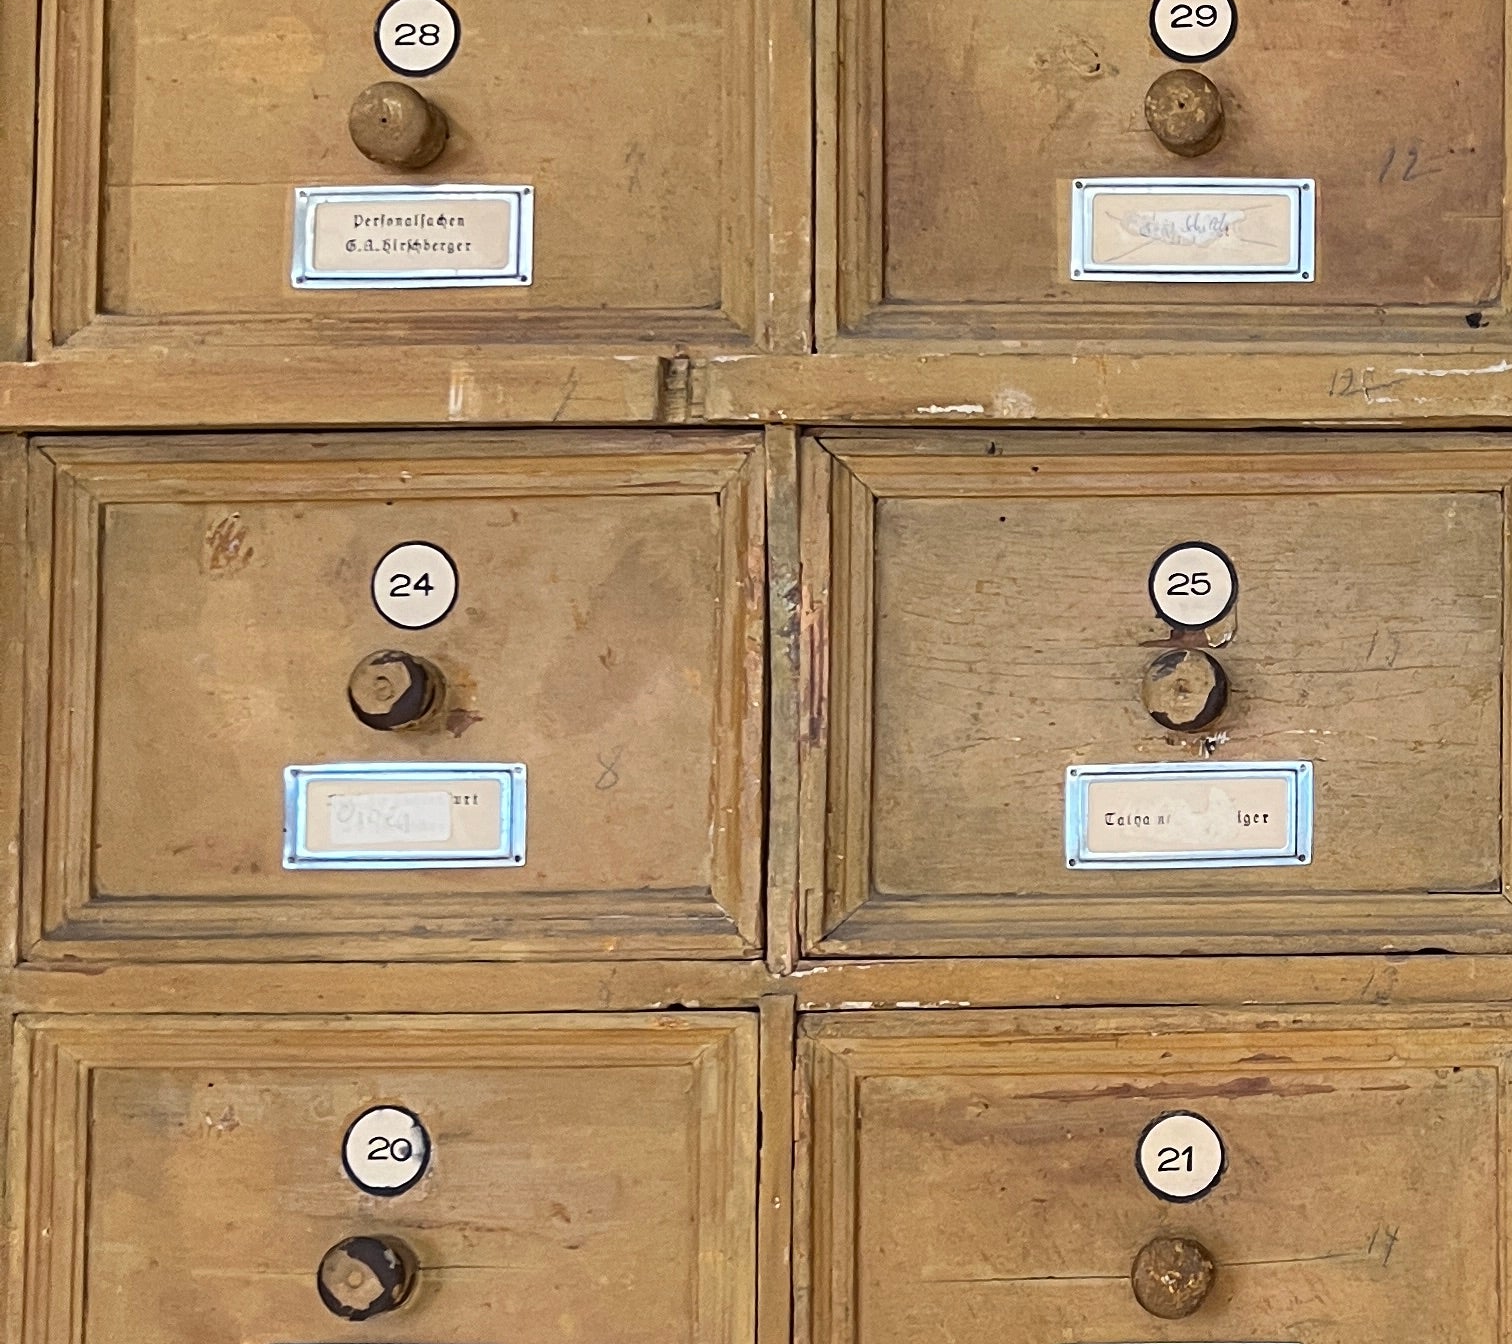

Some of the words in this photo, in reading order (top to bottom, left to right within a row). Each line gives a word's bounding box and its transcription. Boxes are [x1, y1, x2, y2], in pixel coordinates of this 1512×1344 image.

[1170, 3, 1218, 29] 29
[394, 23, 440, 46] 28
[353, 212, 465, 230] Personalsachen
[389, 572, 435, 598] 24
[1166, 572, 1212, 596] 25
[367, 1136, 413, 1162] 20
[1157, 1145, 1193, 1173] 21
